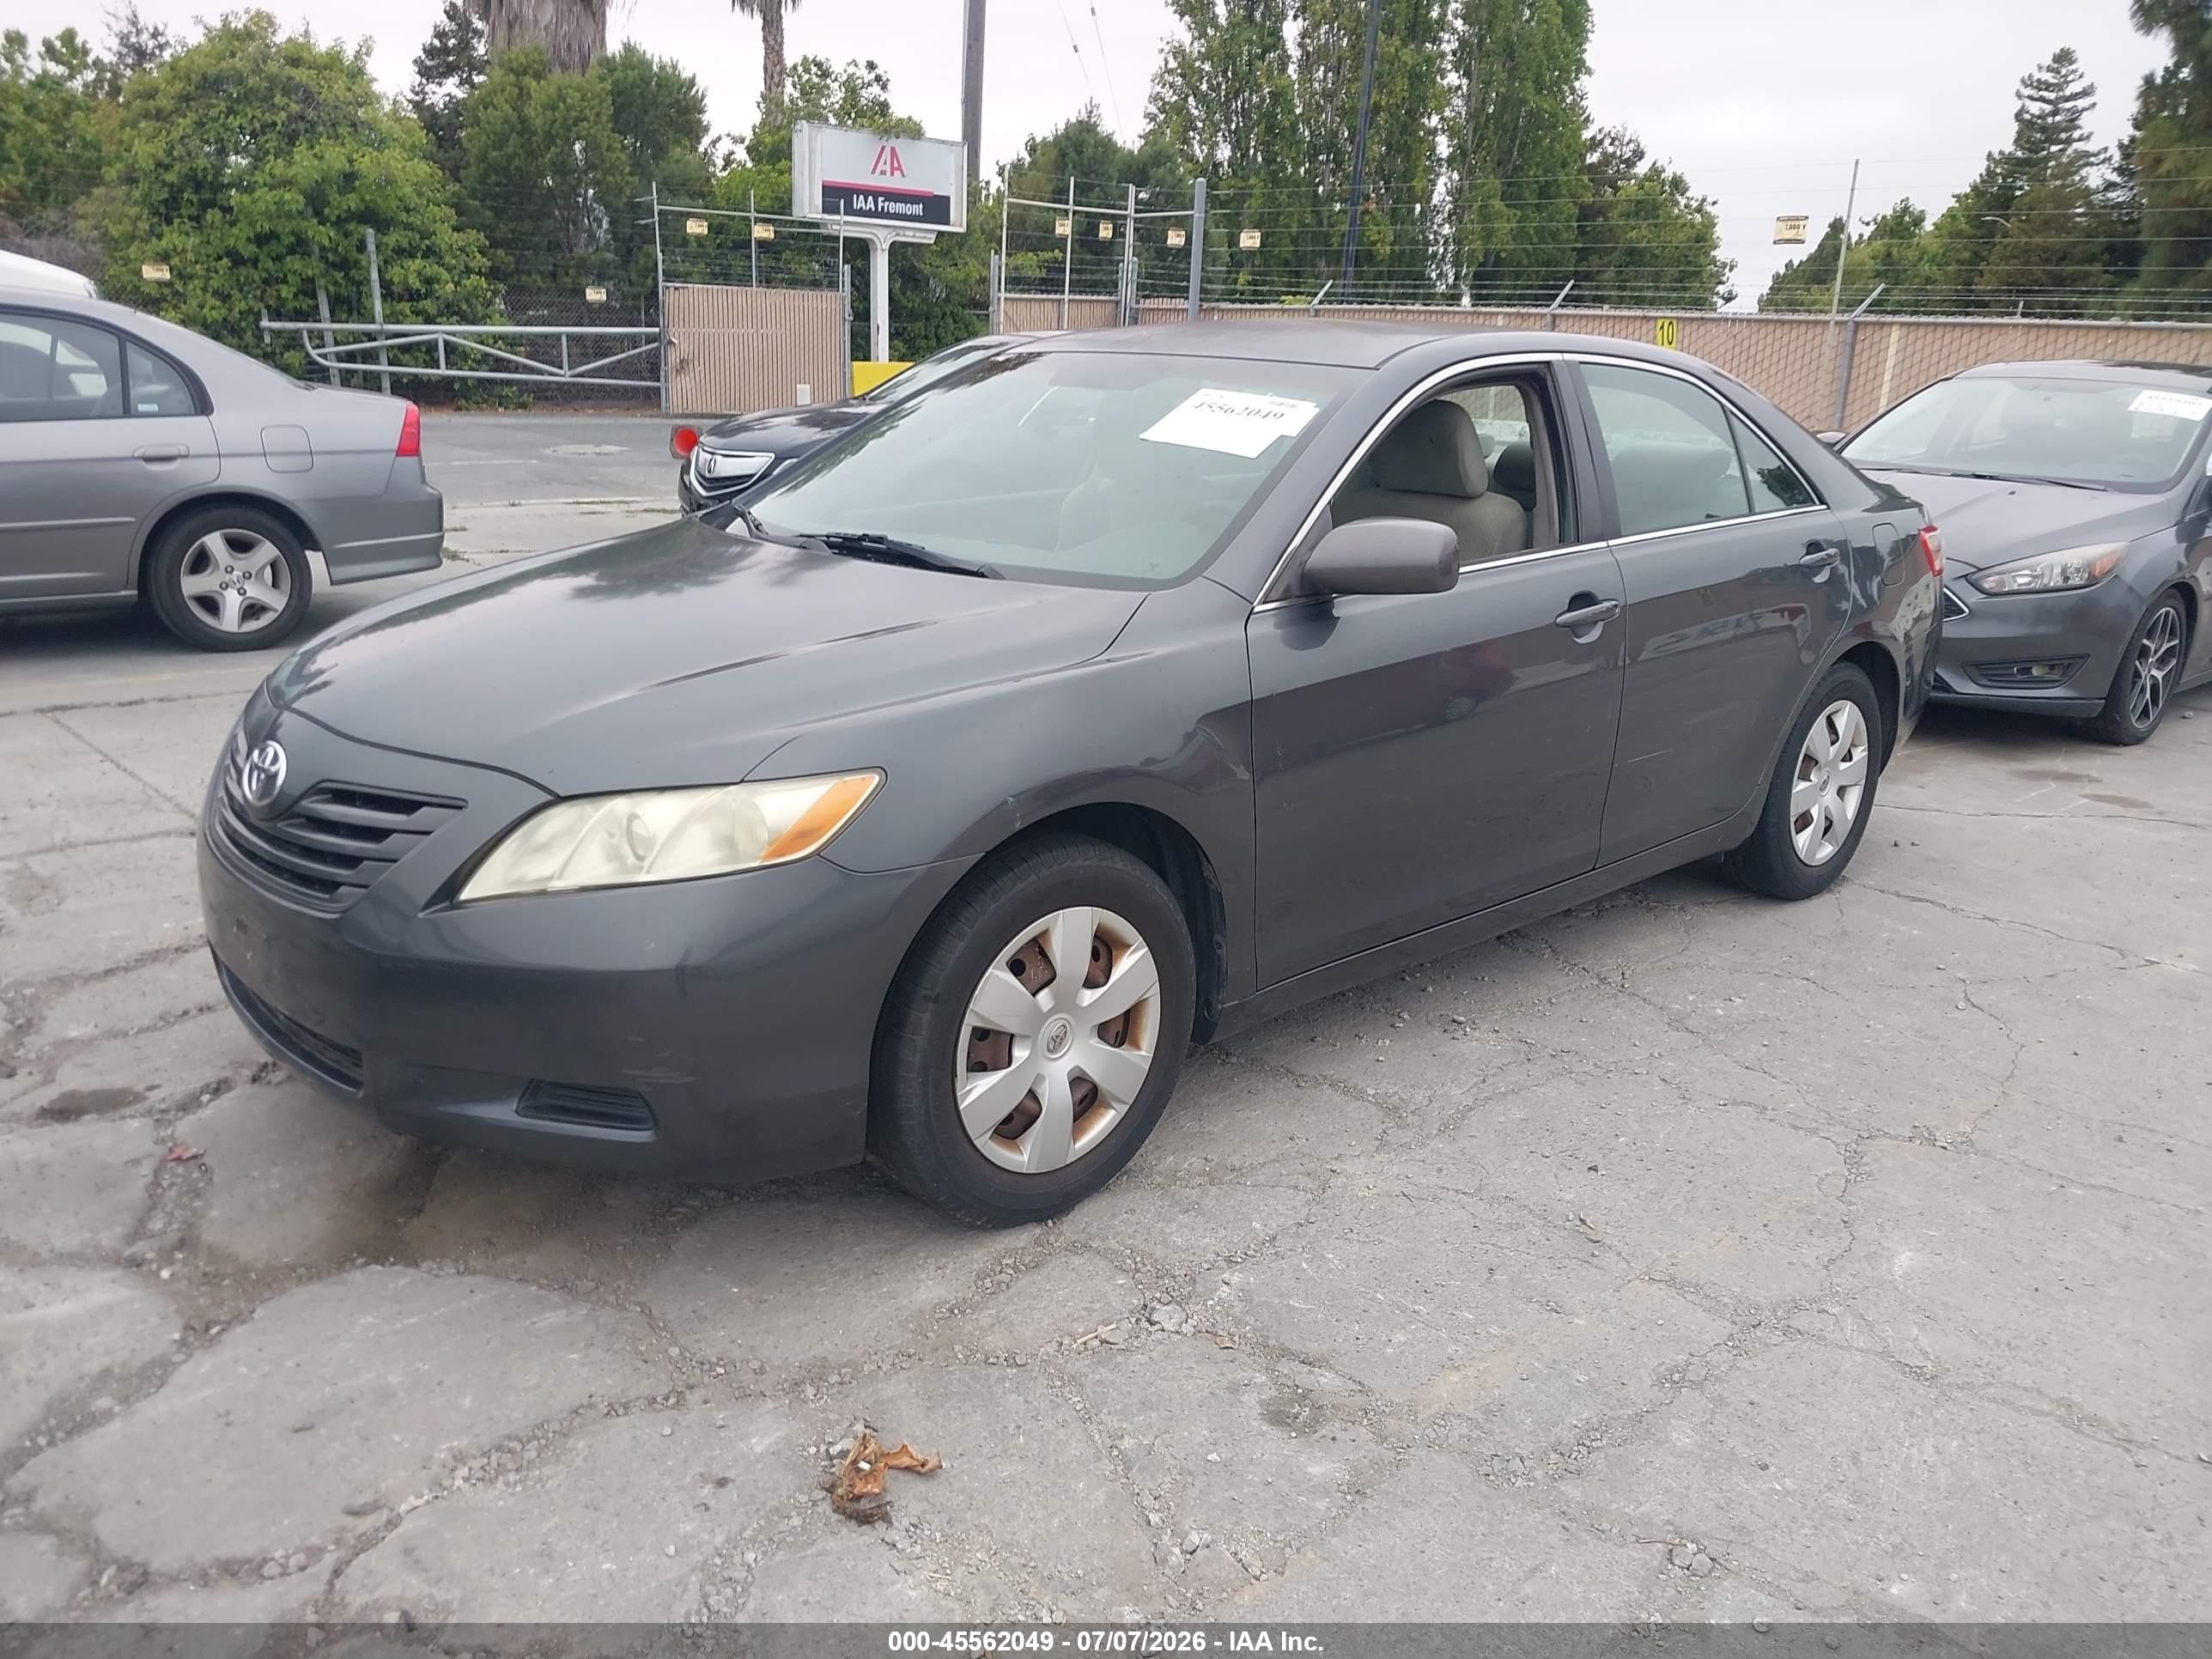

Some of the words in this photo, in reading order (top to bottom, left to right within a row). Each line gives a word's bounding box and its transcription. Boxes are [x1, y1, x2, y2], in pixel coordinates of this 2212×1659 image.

[853, 194, 875, 211] IAA
[878, 197, 924, 216] Fremont
[1659, 320, 1674, 346] 10
